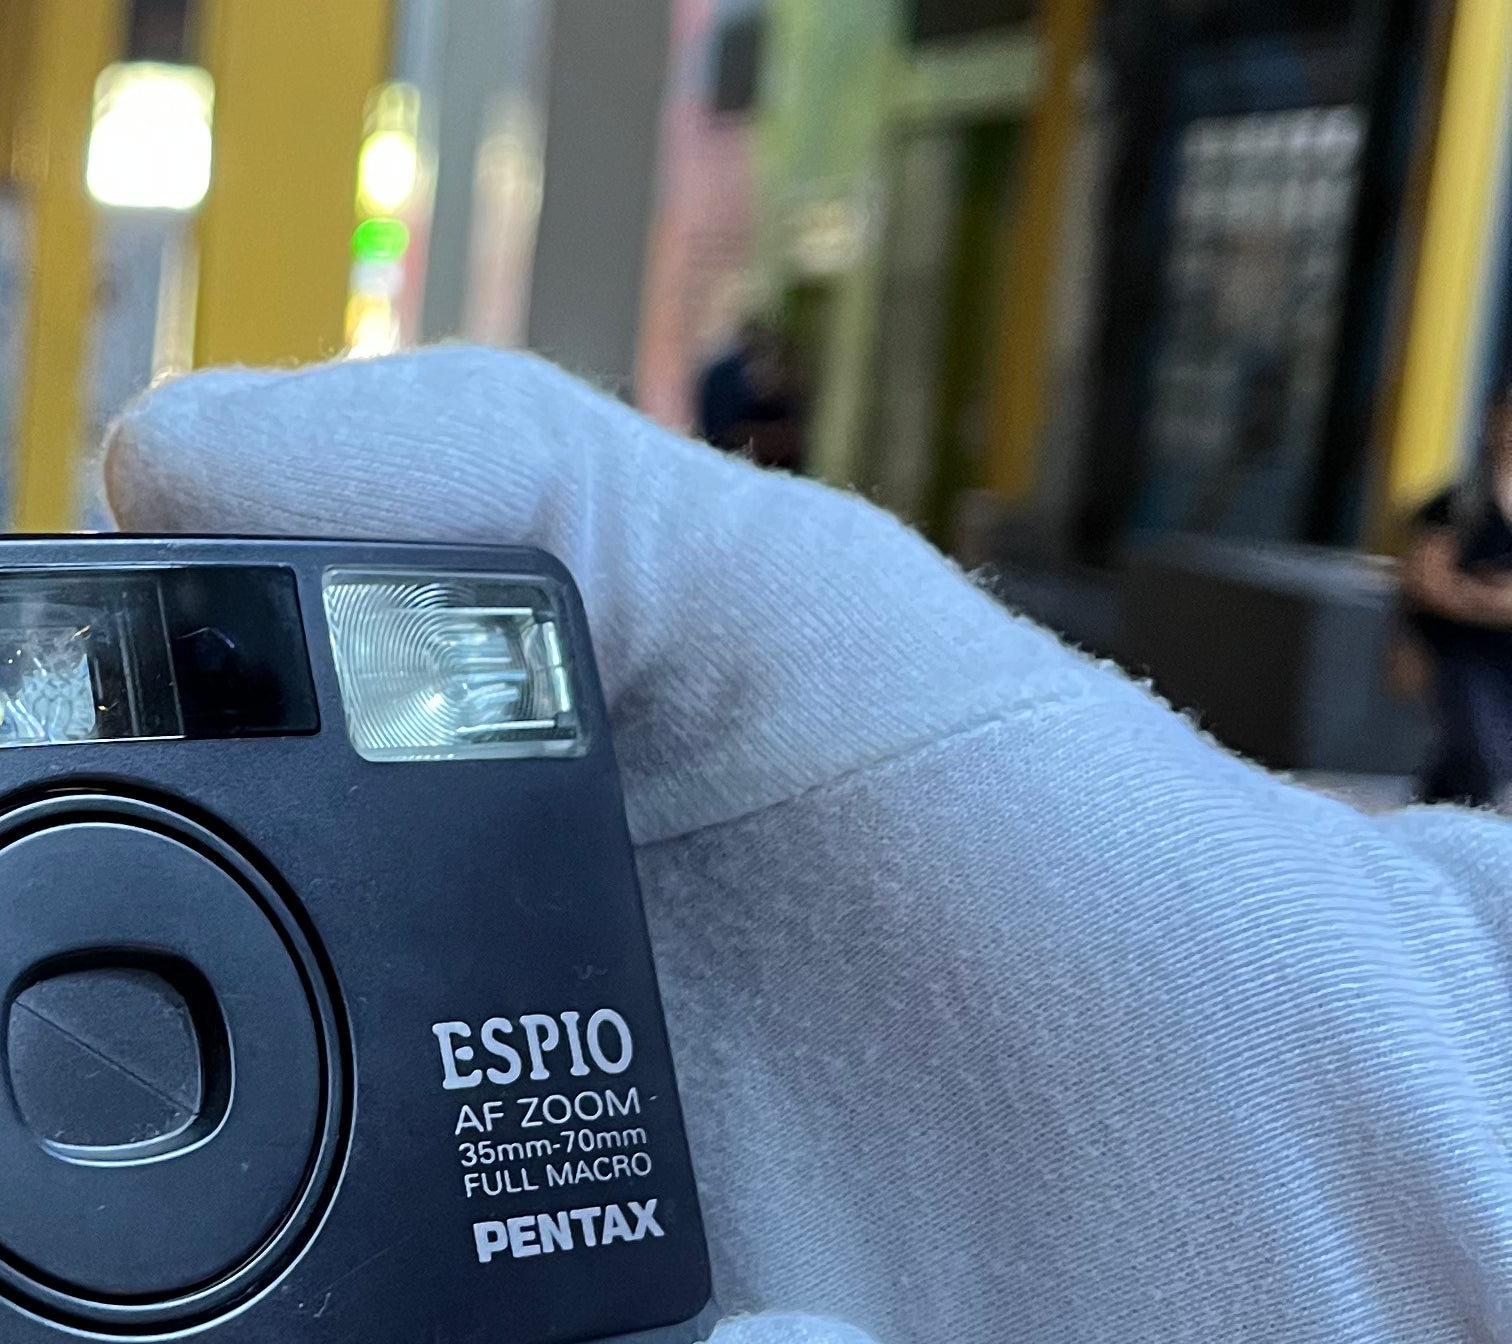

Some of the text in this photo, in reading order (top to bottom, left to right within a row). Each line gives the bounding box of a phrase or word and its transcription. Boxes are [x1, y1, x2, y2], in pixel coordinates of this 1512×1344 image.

[431, 1008, 633, 1090] ESPIO
[454, 1087, 641, 1136] AF ZOOM
[458, 1127, 647, 1168] 35mm-70mm
[463, 1152, 652, 1198] FULL MACRO
[473, 1198, 665, 1263] PENTAX
